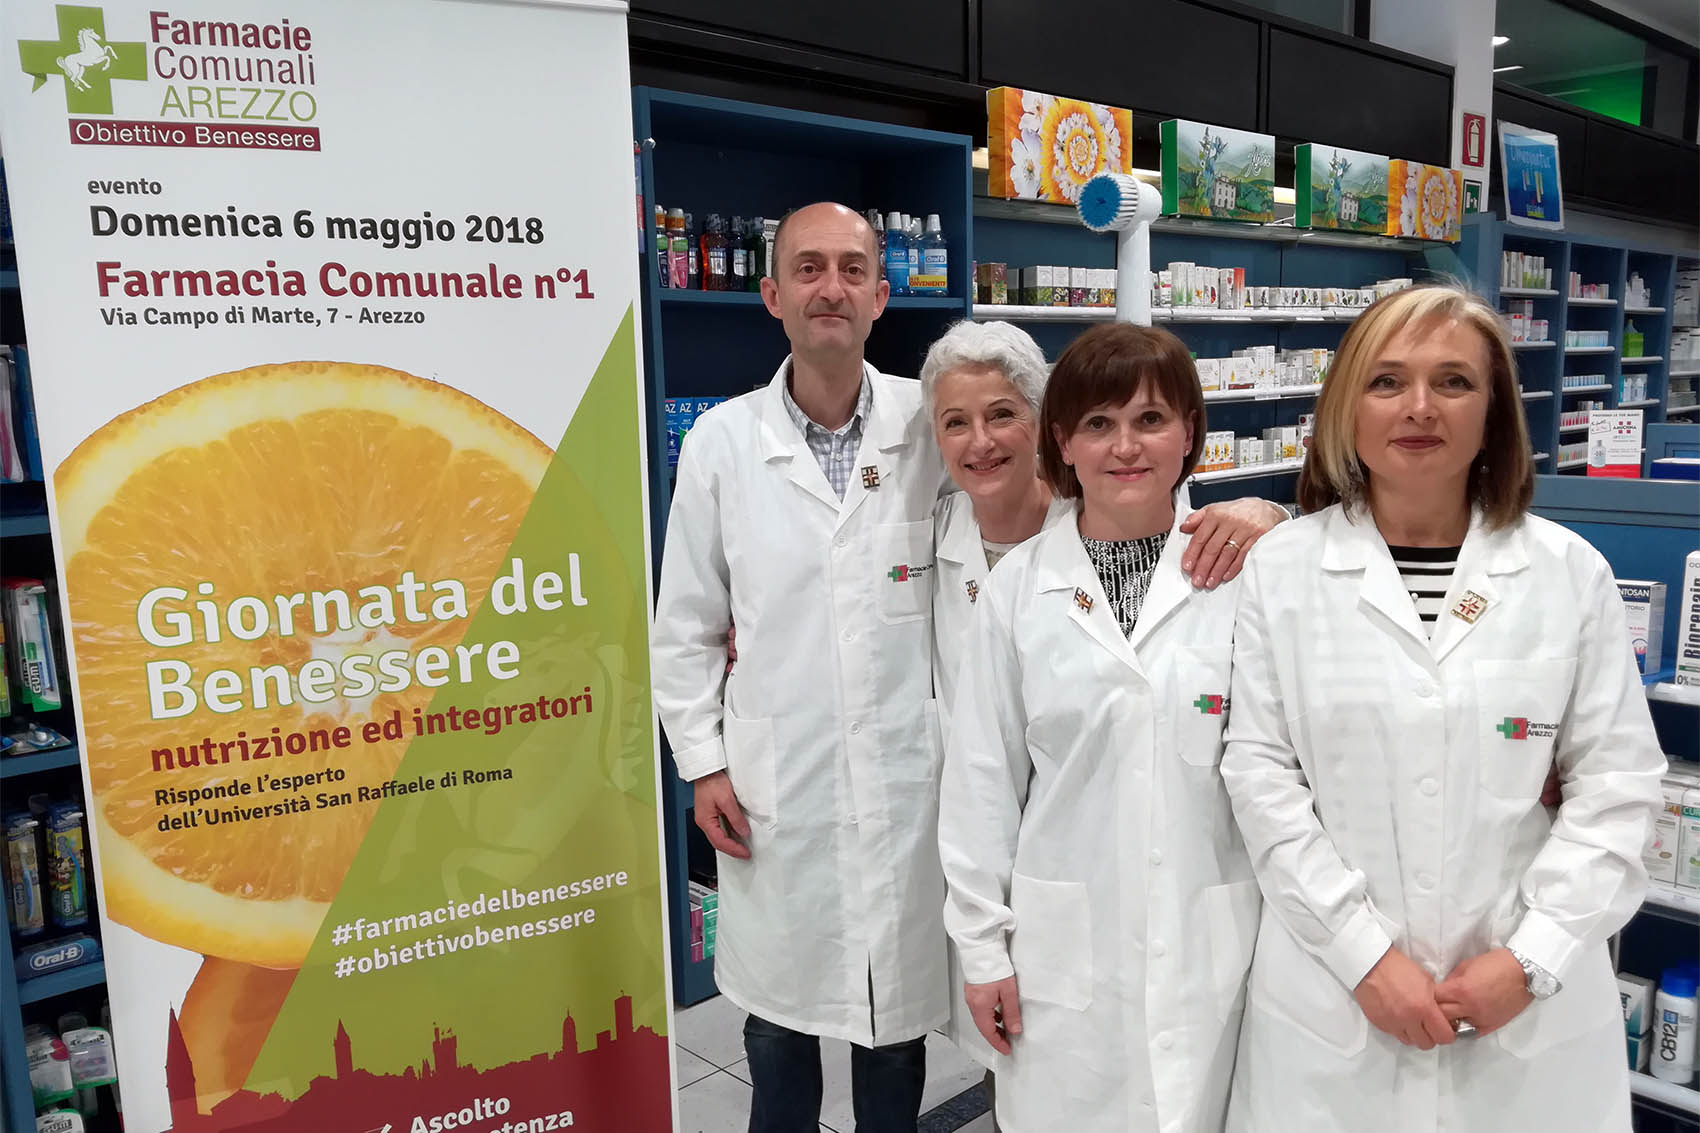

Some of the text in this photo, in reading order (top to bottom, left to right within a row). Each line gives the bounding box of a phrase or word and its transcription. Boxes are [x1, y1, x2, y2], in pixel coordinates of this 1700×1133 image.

[150, 11, 312, 50] Farmacie
[154, 46, 316, 85] Comunali
[160, 85, 317, 121] AREZZO
[75, 122, 315, 148] Obiettivo Benessere
[87, 178, 162, 195] evento
[90, 205, 544, 249] Domenica 6 maggio 2018
[96, 260, 306, 297] Farmacia
[319, 262, 522, 299] Comunale
[100, 307, 137, 325] Via
[143, 307, 219, 328] Campo
[225, 305, 245, 324] di
[251, 306, 321, 327] Marte,
[327, 307, 339, 324] 7
[358, 307, 426, 325] Arezzo
[680, 402, 692, 413] AZ
[136, 552, 589, 648] Giornata del
[146, 640, 520, 720] Benessere
[151, 686, 593, 772] nutrizione ed integratori
[154, 779, 252, 806] Risponde
[316, 791, 352, 809] San
[357, 775, 435, 803] Raffaele
[440, 771, 458, 788] di
[463, 767, 513, 785] Roma
[331, 870, 629, 946] #farmaciedelbenessere
[33, 947, 79, 968] Oral-B
[334, 907, 596, 979] #obiettivobenessere
[1660, 1023, 1678, 1062] CB12
[409, 1096, 511, 1133] Ascolto
